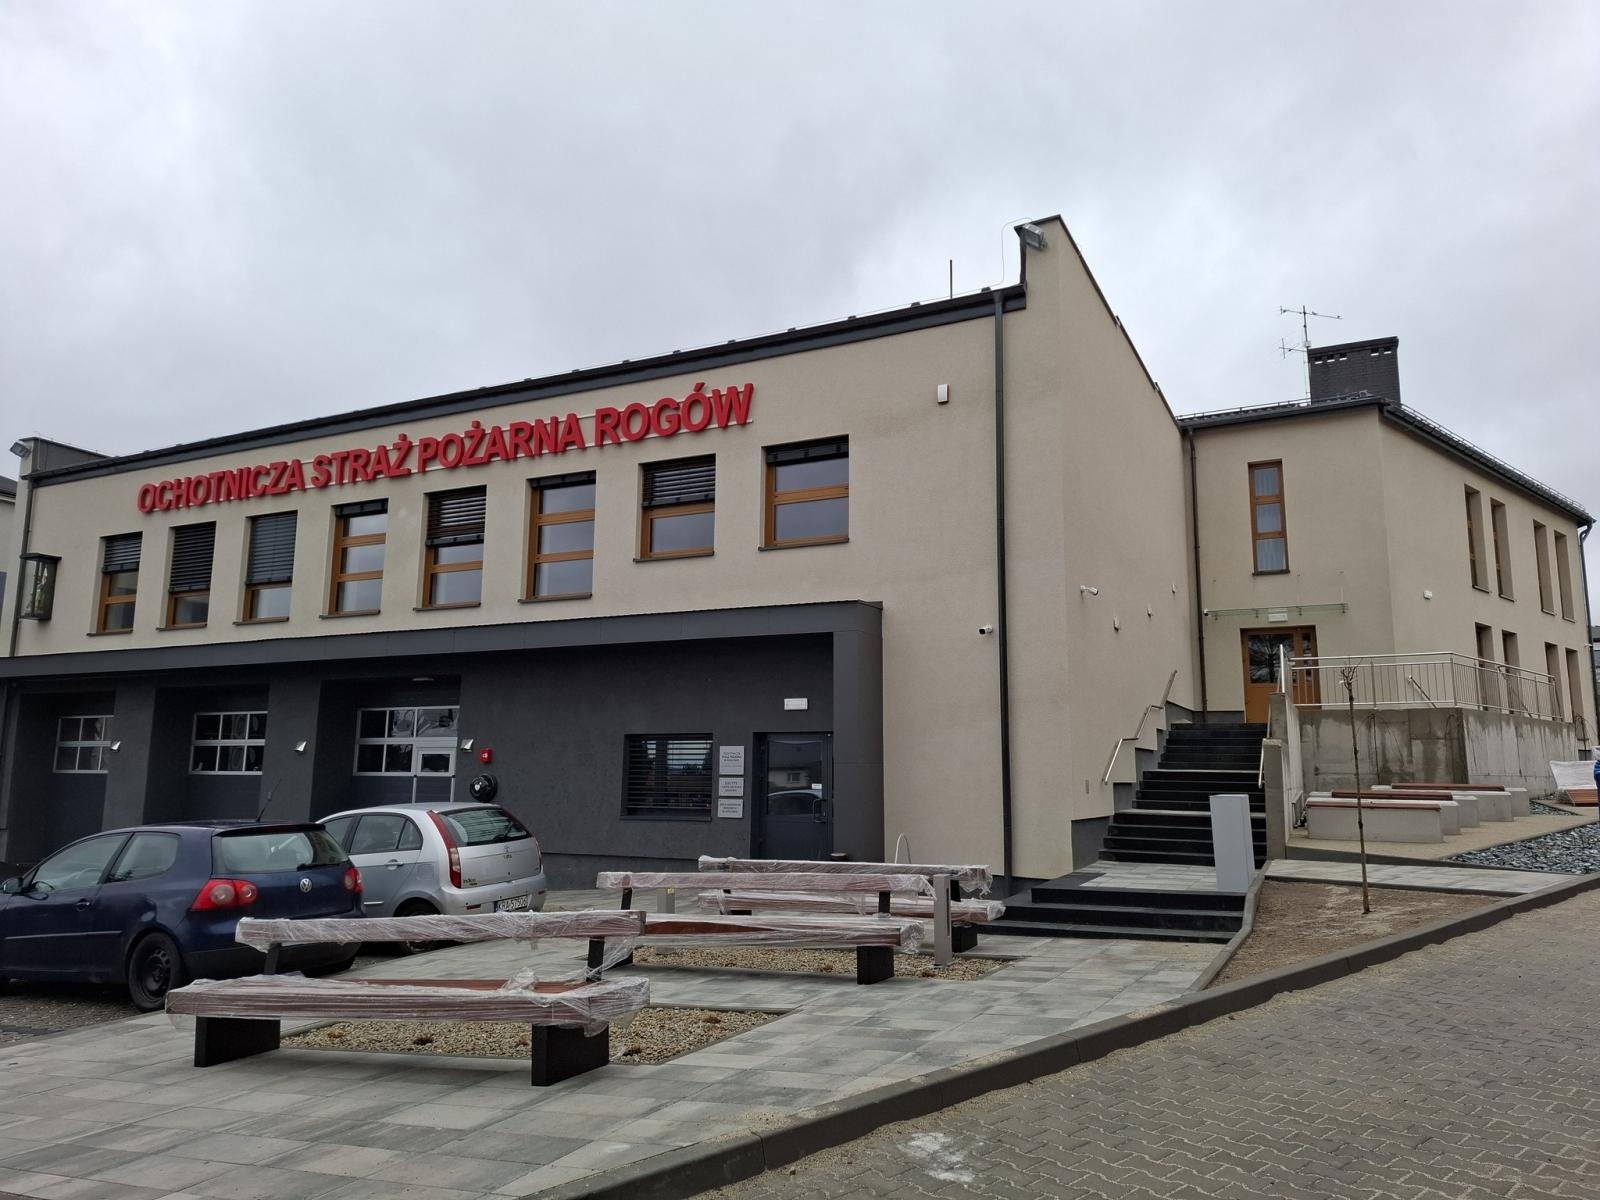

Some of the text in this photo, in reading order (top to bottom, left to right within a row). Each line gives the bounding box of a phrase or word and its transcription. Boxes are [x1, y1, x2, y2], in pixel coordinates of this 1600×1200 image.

[137, 382, 754, 514] OCHOTNICZA STRAŻ POŻARNA ROGÓW
